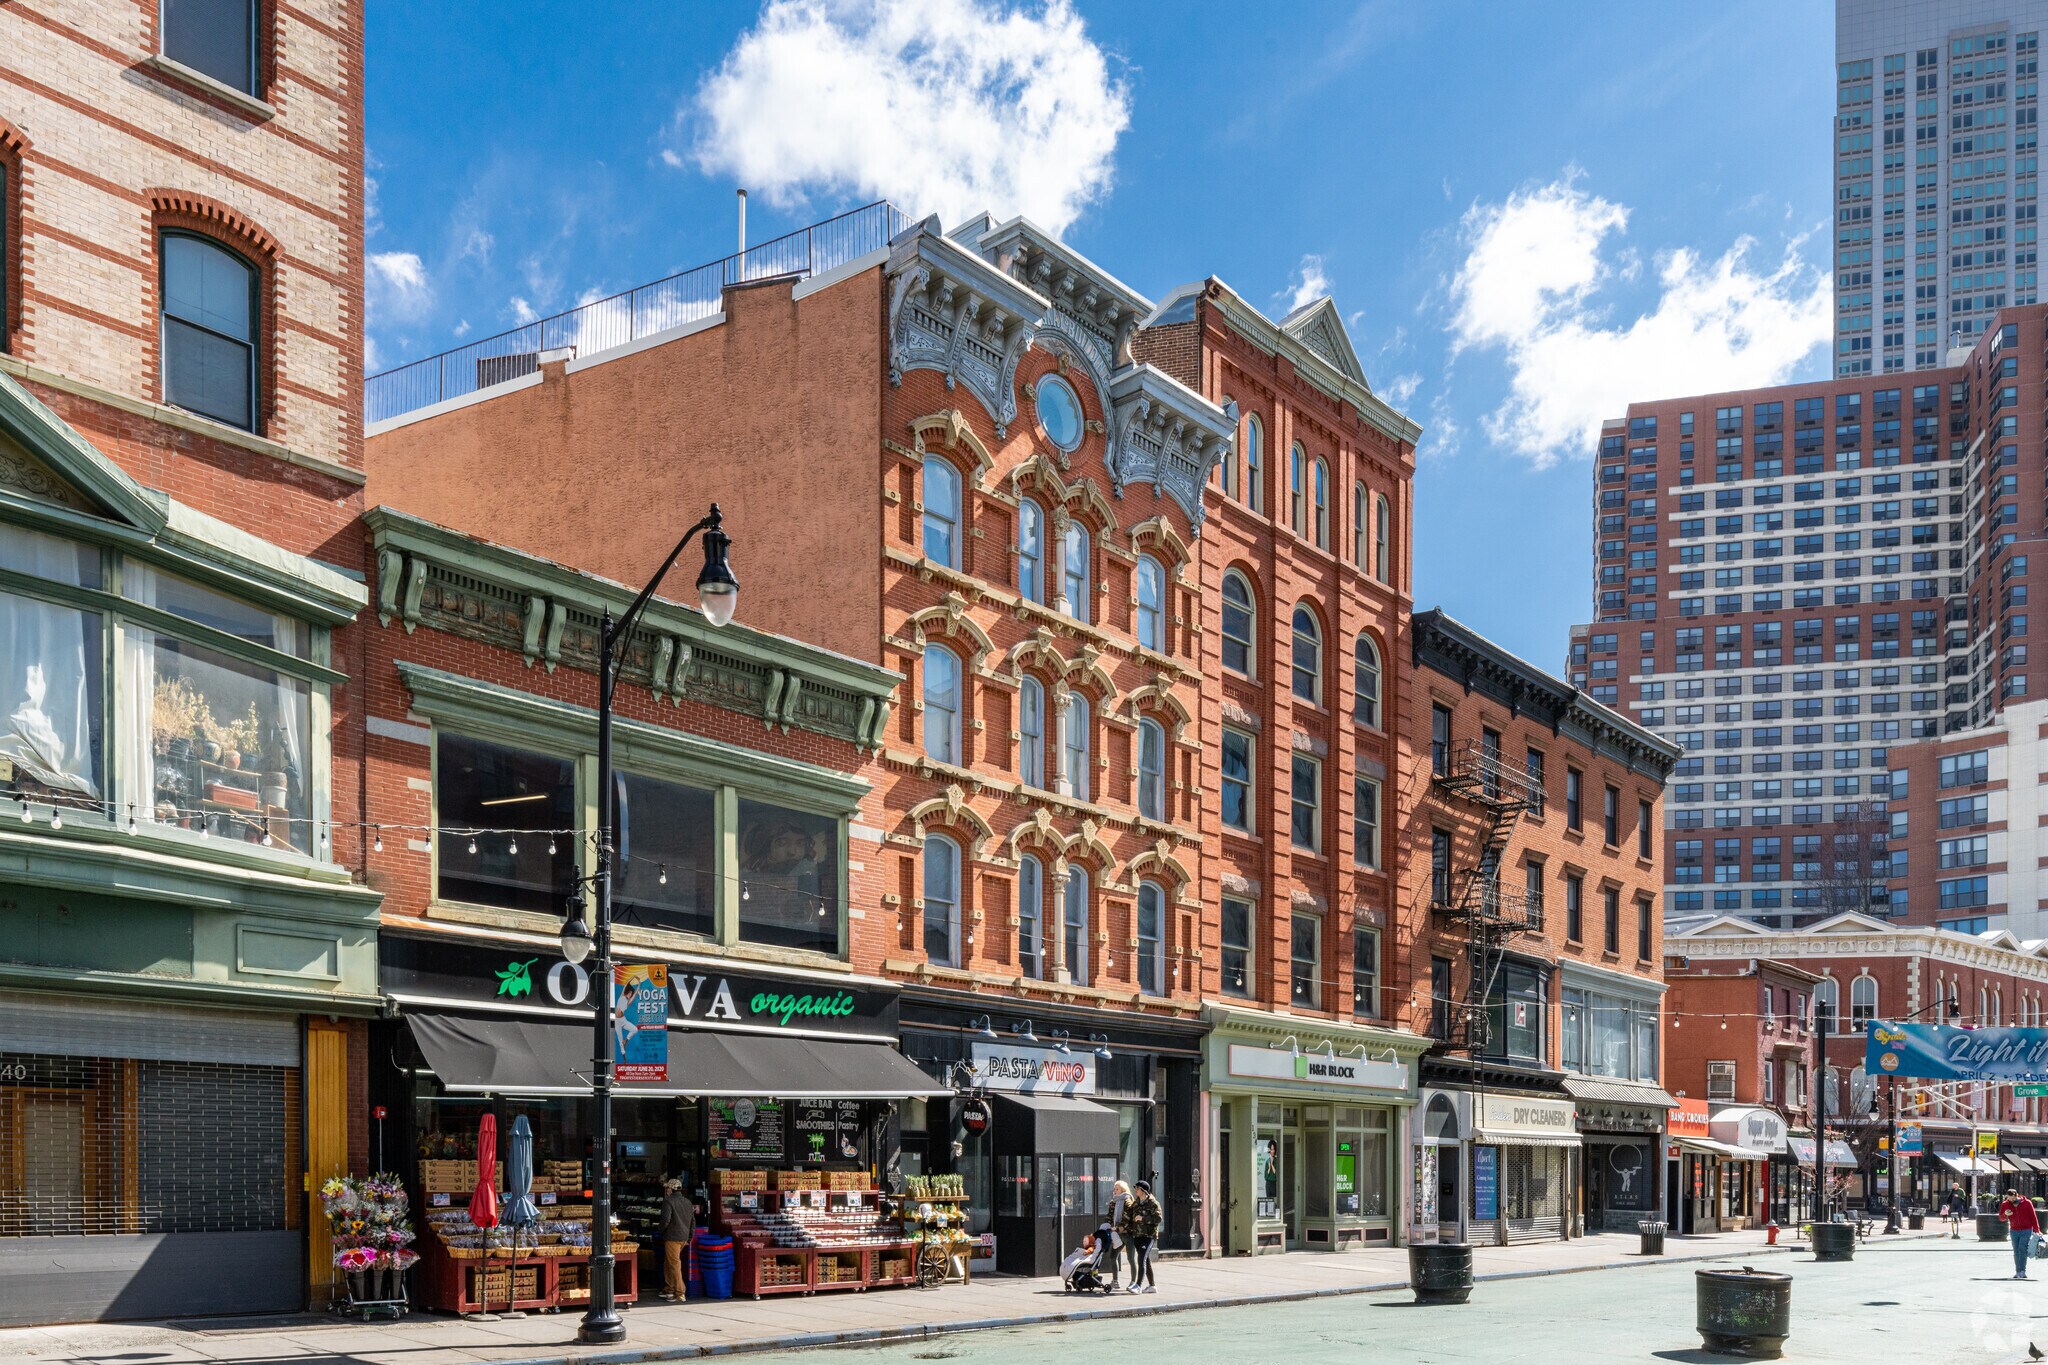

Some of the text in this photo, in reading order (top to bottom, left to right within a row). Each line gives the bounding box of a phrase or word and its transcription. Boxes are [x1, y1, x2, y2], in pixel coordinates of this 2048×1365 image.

[547, 961, 855, 1026] OVA organic
[637, 988, 667, 1001] YOGA
[637, 1001, 667, 1014] FEST
[1947, 1034, 2025, 1069] Light
[988, 1055, 1040, 1079] PASTA
[1043, 1060, 1086, 1083] VINO
[1309, 1063, 1355, 1079] H&R BLOCK
[1952, 1070, 1985, 1081] APRIL
[1989, 1072, 1996, 1081] 2
[2017, 1086, 2039, 1096] Grove
[799, 1098, 833, 1109] JUICE BAR
[837, 1100, 860, 1110] Coffee
[1513, 1107, 1530, 1125] DRY
[1530, 1108, 1567, 1127] CLEANERS
[1670, 1111, 1709, 1124] BANG COOKIES
[795, 1119, 835, 1131] SMOOTHIES
[838, 1121, 860, 1132] Pastry
[1336, 1174, 1348, 1182] H&R
[1336, 1182, 1353, 1190] BLOCK
